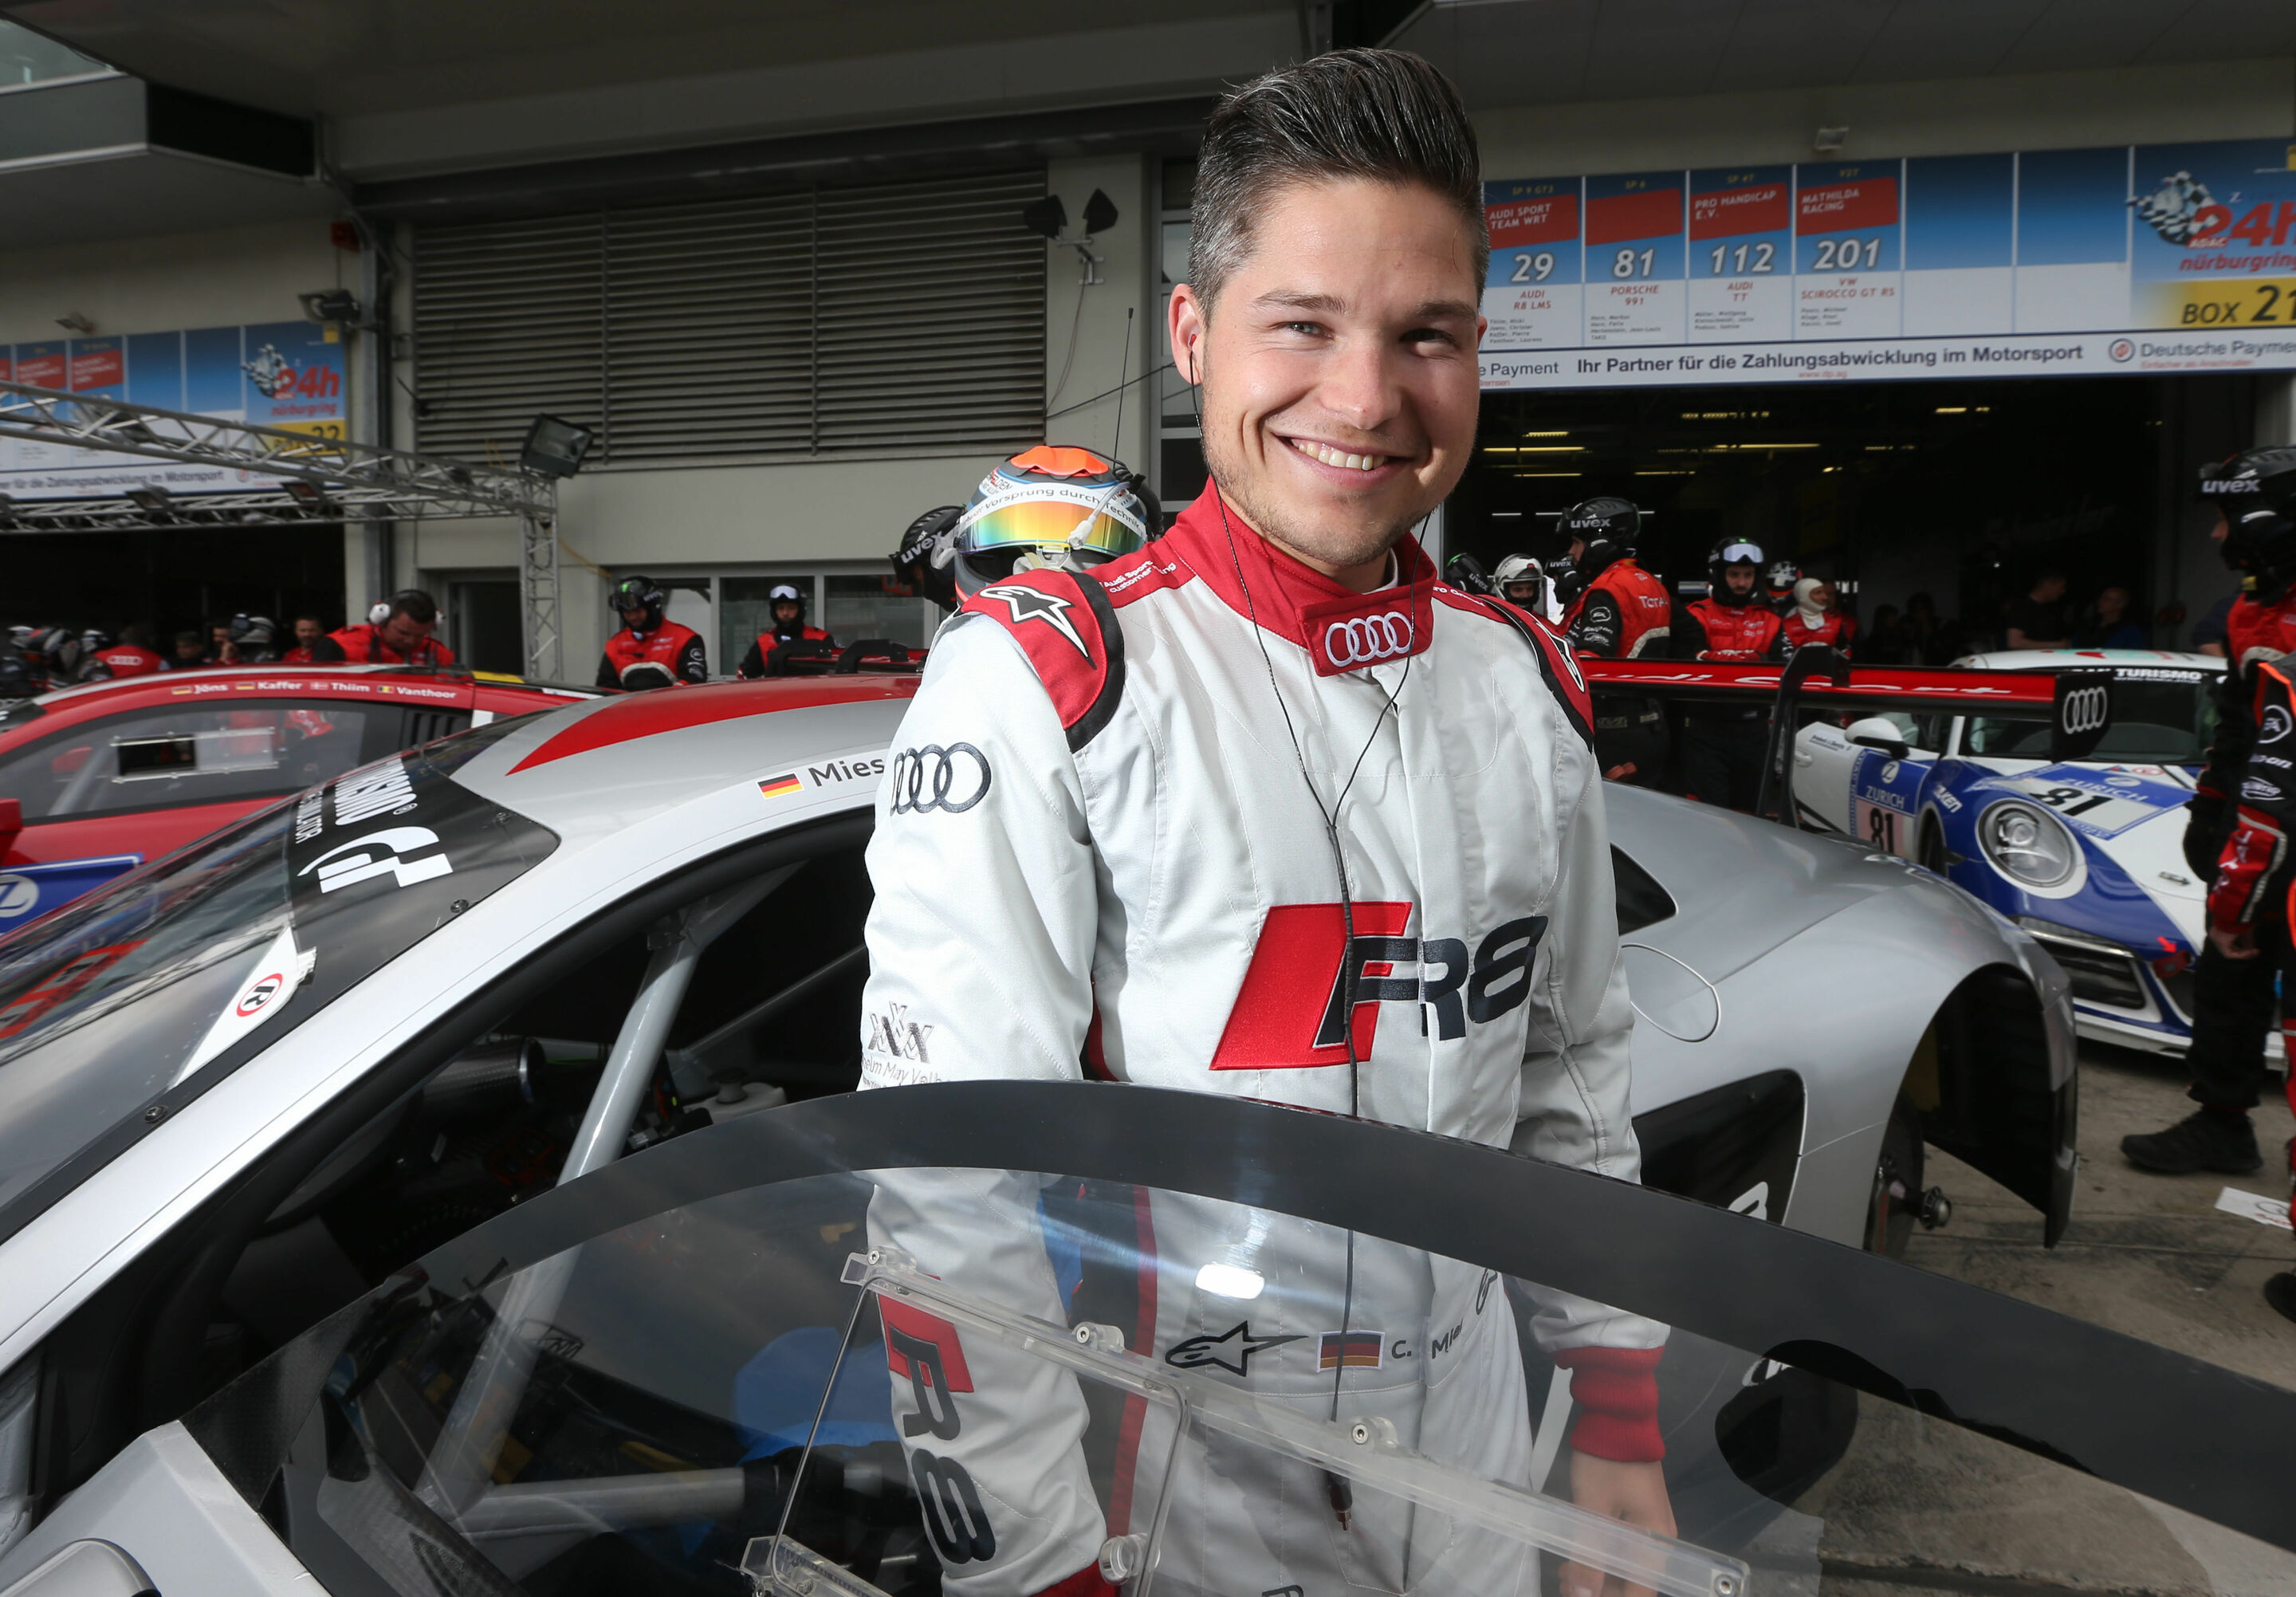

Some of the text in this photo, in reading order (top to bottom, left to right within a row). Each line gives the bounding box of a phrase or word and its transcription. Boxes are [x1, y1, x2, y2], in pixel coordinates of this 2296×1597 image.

[1695, 191, 1777, 210] PRO HANDICAP
[1802, 188, 1859, 204] MATHILDA
[1489, 203, 1551, 220] AUDI SPORT
[1802, 202, 1844, 214] RACING
[1491, 214, 1548, 230] TEAM WRT
[1613, 248, 1655, 278] 81
[1712, 242, 1774, 273] 112
[1812, 238, 1881, 269] 201
[1512, 252, 1555, 282] 29
[1610, 285, 1660, 295] PORSCHE
[1727, 281, 1753, 291] AUDI
[1801, 287, 1895, 300] SCIROCCO GT RS
[1531, 301, 1551, 309] LMS
[1625, 297, 1645, 305] 991
[1733, 293, 1748, 301] TT
[2181, 302, 2241, 325] BOX
[2141, 341, 2227, 358] Deutsche
[1491, 345, 2083, 378] Payment Ihr Partner für die Zahlungsabwicklung im Motorsport
[277, 365, 340, 398] 24h
[2202, 479, 2261, 493] uvex
[985, 488, 1054, 509] Vorsprung
[1568, 518, 1611, 529] uvex
[1103, 561, 1154, 587] Audi Sport
[1469, 572, 1489, 592] uvex
[2115, 667, 2204, 682] TURISMO
[194, 681, 458, 699] Jöns Kaffer Thiim Vanthoor
[808, 758, 884, 787] Mies
[1866, 777, 1905, 809] ZURICH
[2030, 787, 2114, 817] 81
[1870, 808, 1894, 854] 81
[1391, 1339, 1412, 1359] C.
